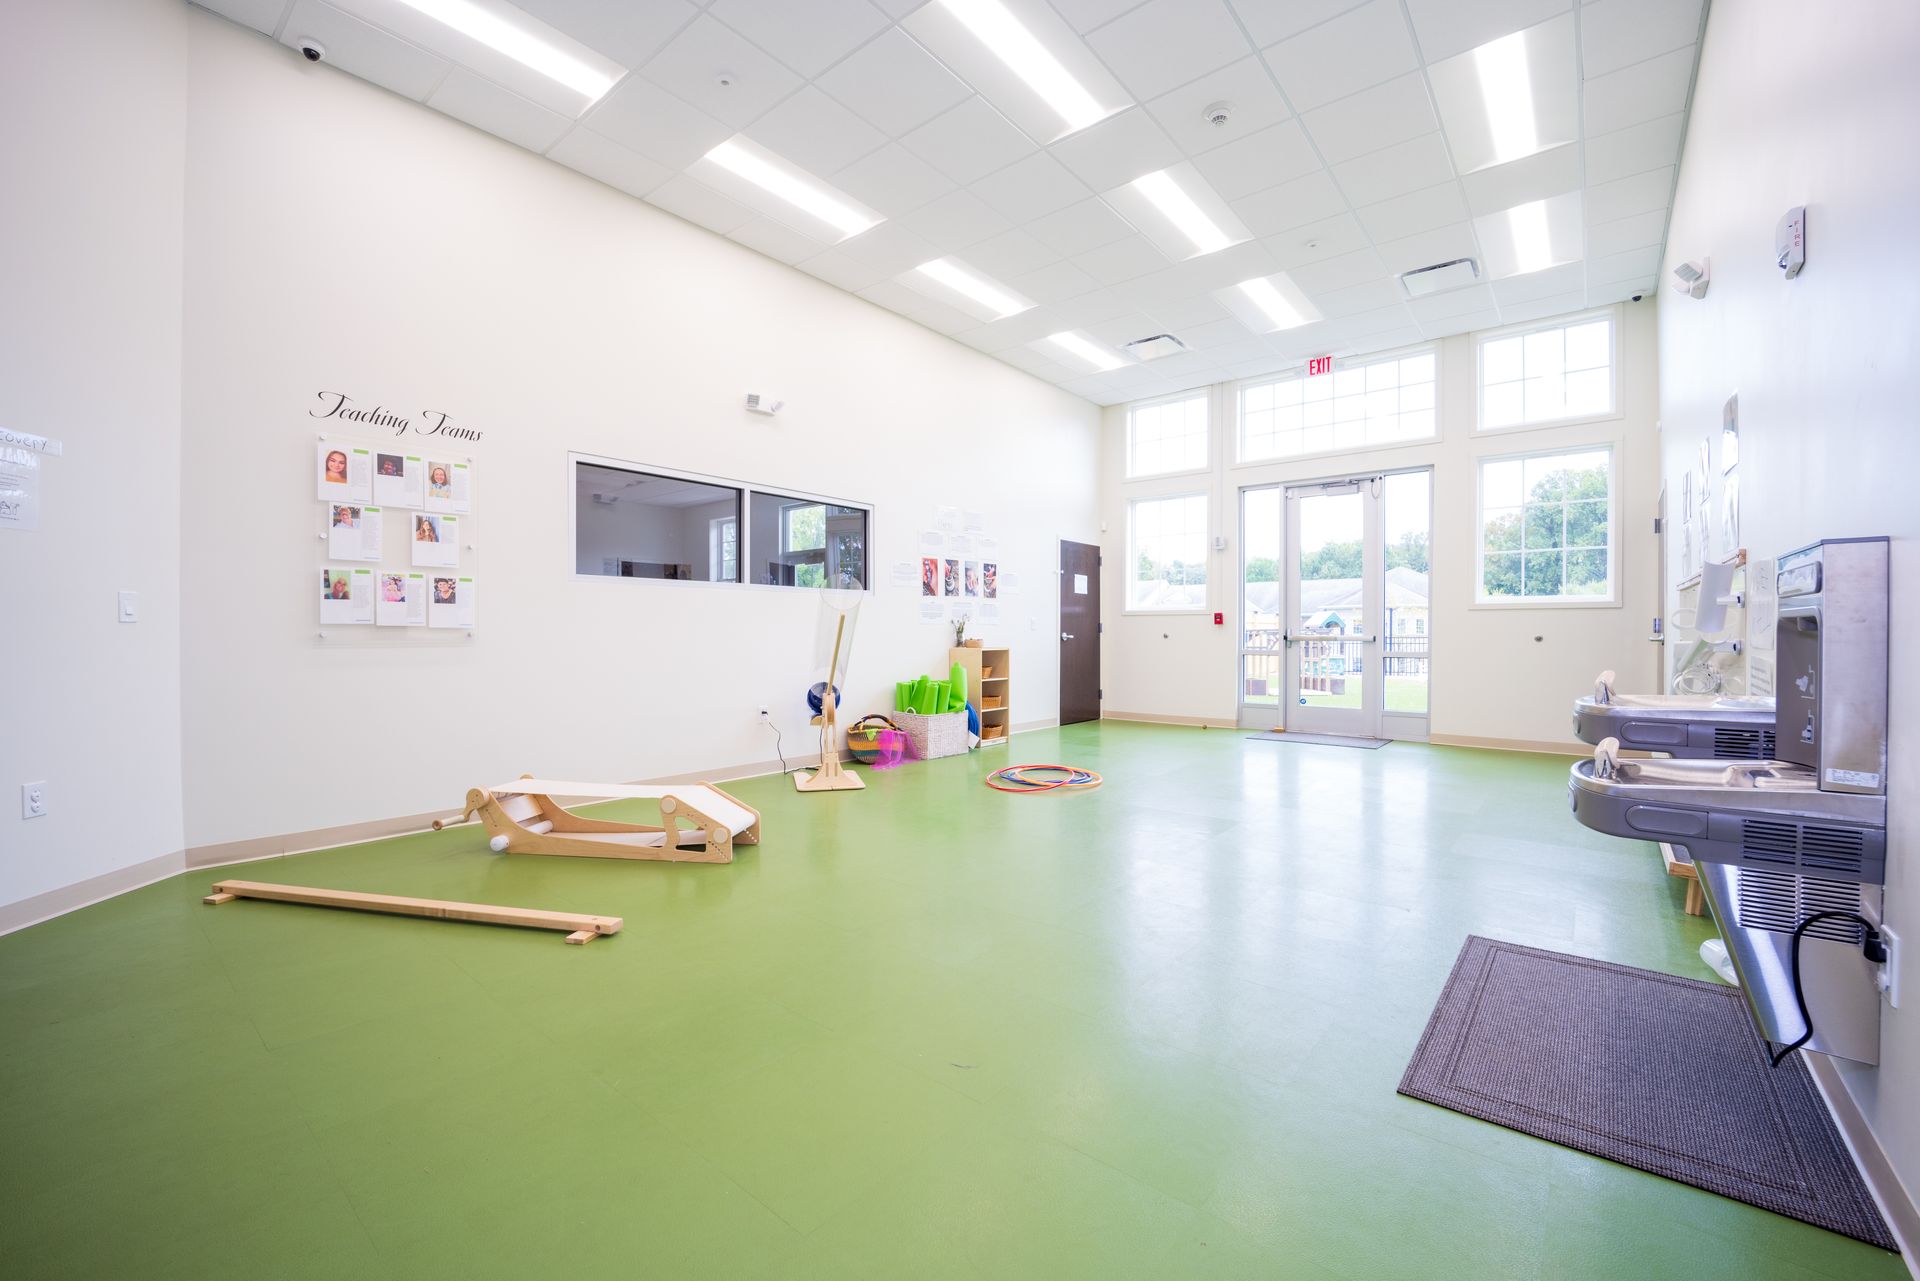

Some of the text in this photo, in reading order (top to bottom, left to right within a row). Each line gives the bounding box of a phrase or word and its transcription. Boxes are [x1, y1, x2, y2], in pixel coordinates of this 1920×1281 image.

[1793, 219, 1802, 248] FIRE
[1309, 356, 1332, 376] EXIT
[309, 390, 484, 442] Teaching Teams
